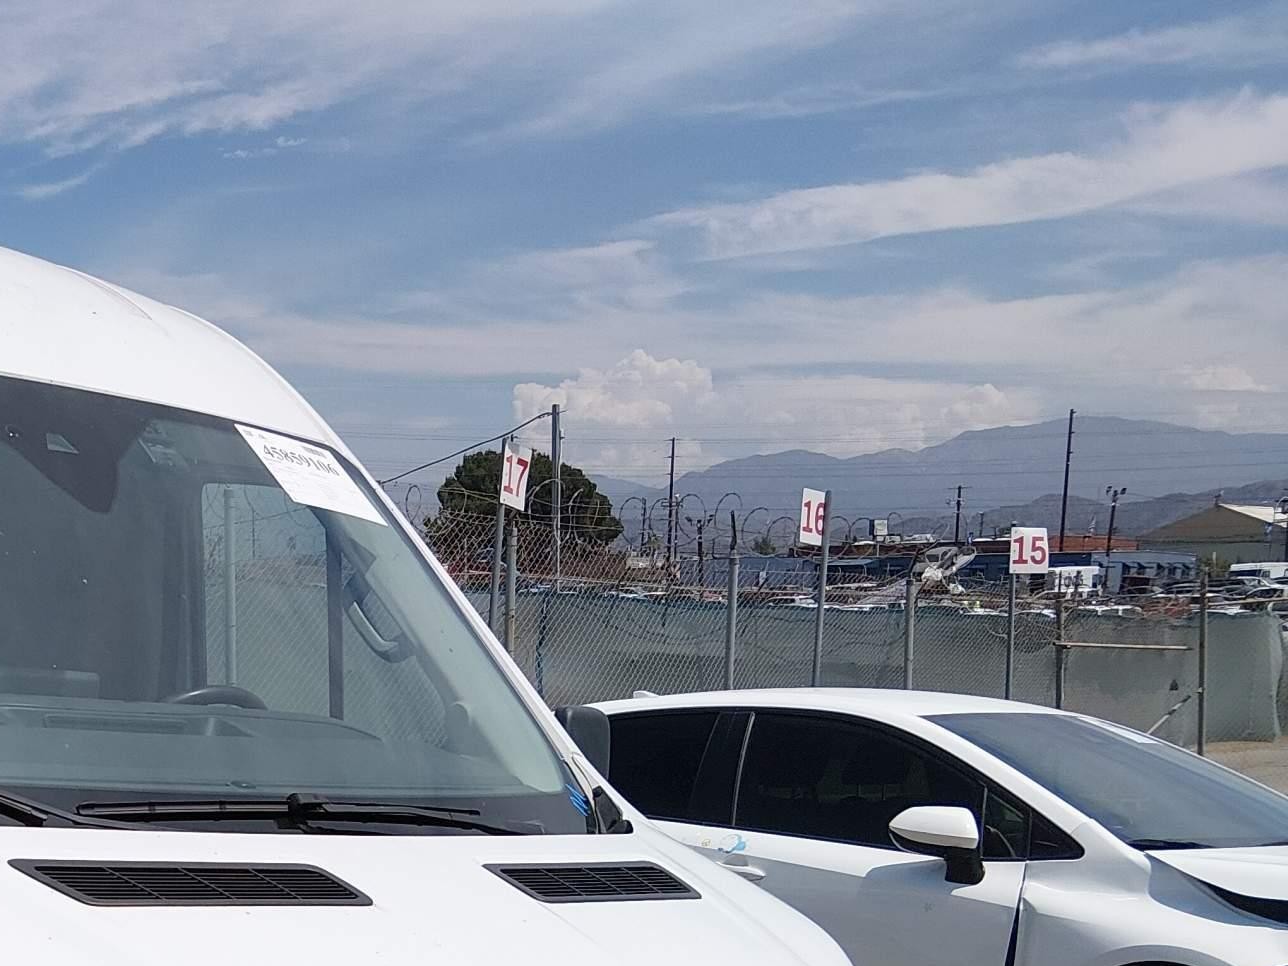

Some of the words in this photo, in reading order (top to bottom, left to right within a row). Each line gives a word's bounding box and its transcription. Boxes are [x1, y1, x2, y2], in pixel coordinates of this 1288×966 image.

[262, 443, 341, 477] 45859106
[503, 454, 529, 497] 17
[802, 500, 825, 536] 16
[1013, 536, 1047, 565] 15
